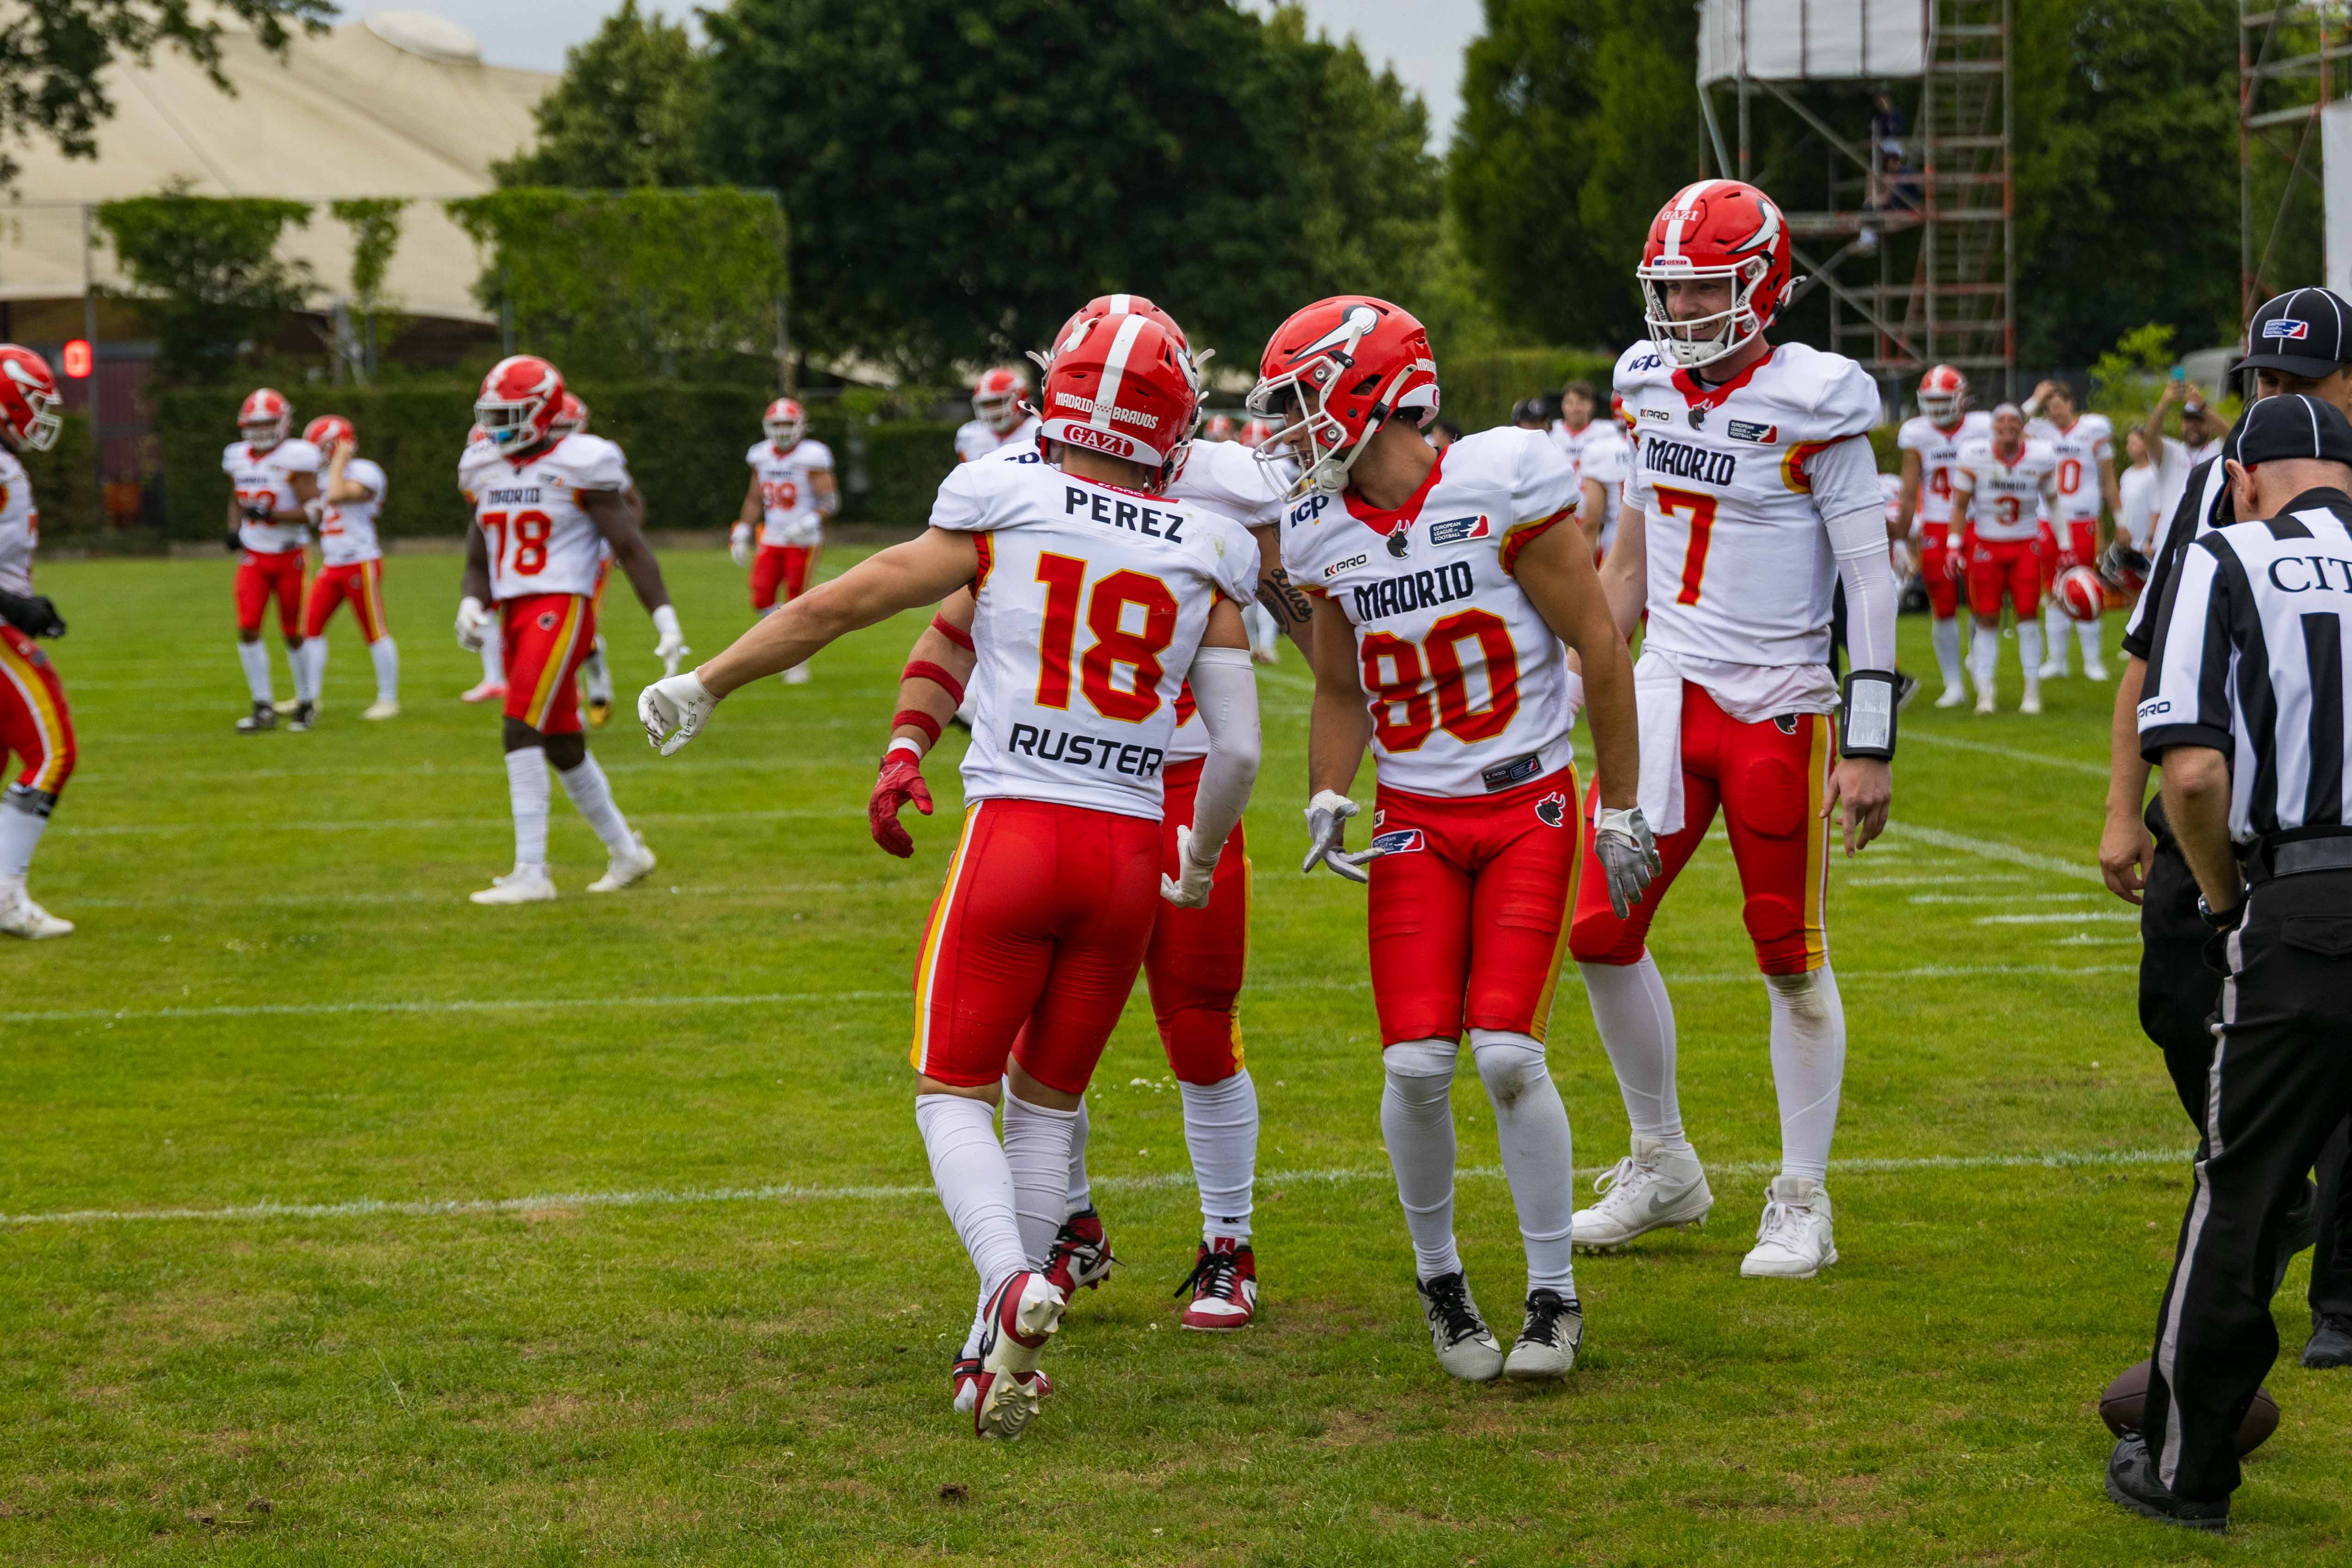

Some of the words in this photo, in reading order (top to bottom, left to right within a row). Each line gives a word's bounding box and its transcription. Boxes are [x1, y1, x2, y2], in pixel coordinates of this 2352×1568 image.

[1055, 392, 1094, 413] MADRID
[1112, 406, 1159, 429] BRAVOS
[1646, 437, 1736, 486] MADRID
[1065, 485, 1184, 544] PEREZ
[1290, 495, 1329, 529] icp
[1433, 521, 1461, 531] EUROPEAN
[1434, 528, 1453, 536] LEAGUE
[1434, 532, 1461, 542] FOOTBALL
[481, 510, 552, 583] 78
[1652, 483, 1718, 607] 7
[1354, 561, 1474, 622] MADRID
[1035, 550, 1179, 724] 18
[1360, 606, 1520, 754] 80
[1008, 723, 1164, 776] RUSTER
